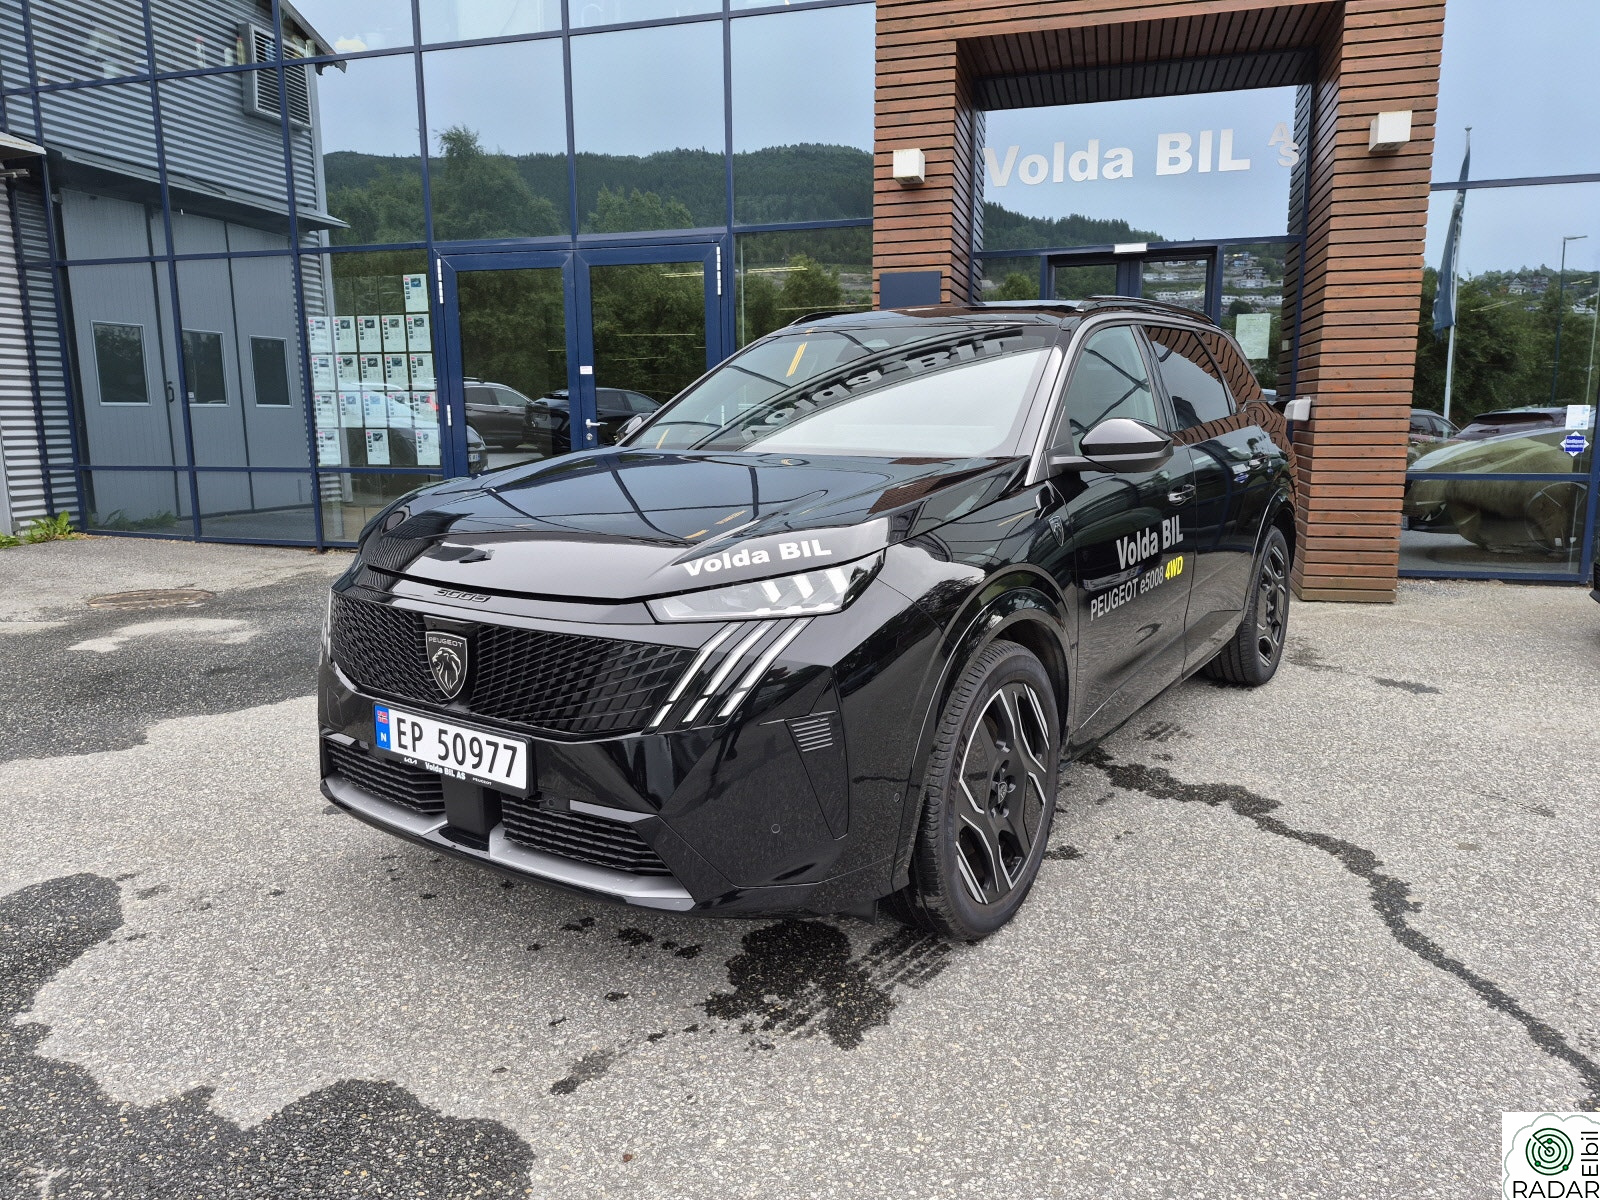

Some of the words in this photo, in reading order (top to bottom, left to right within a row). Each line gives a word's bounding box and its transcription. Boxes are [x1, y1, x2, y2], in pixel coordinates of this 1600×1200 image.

[982, 139, 1133, 187] Volda
[1156, 129, 1250, 176] BIL
[1116, 527, 1158, 570] Volda
[1162, 514, 1184, 550] BIL
[683, 549, 770, 577] Volda
[779, 539, 833, 561] BIL
[434, 588, 491, 603] 5008
[1090, 578, 1138, 621] PEUGEOT
[1140, 565, 1164, 594] e5008
[1165, 555, 1184, 580] 4WD
[428, 636, 463, 648] PEUGEOT
[380, 732, 387, 743] N
[396, 717, 424, 753] EP
[438, 728, 518, 778] 50977
[424, 762, 443, 774] Volda
[444, 767, 456, 778] BIL
[456, 770, 467, 781] AS
[472, 776, 493, 786] PEUGEOT
